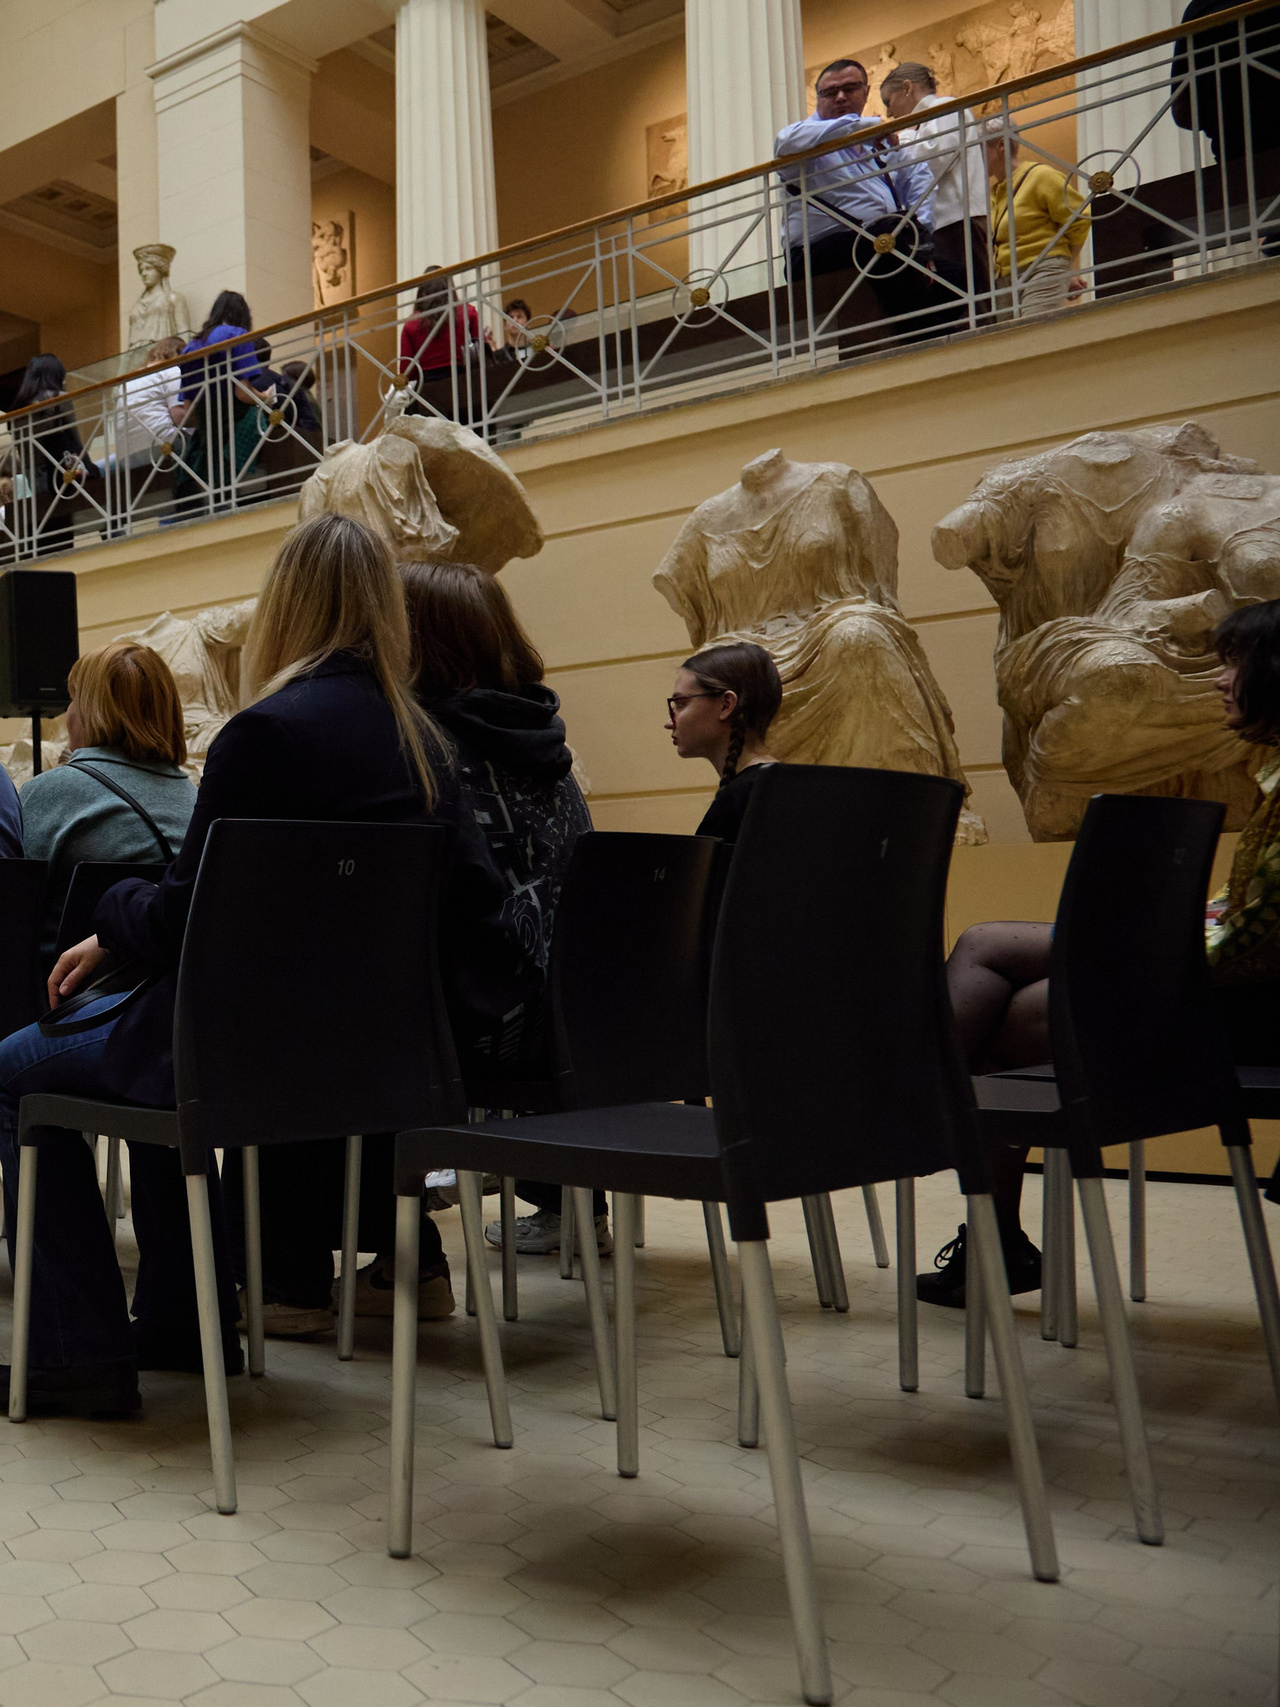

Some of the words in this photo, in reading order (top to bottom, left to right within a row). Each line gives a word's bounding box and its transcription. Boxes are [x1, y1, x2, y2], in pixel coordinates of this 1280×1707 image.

[880, 838, 888, 859] 1
[337, 859, 355, 875] 10
[653, 867, 666, 882] 14
